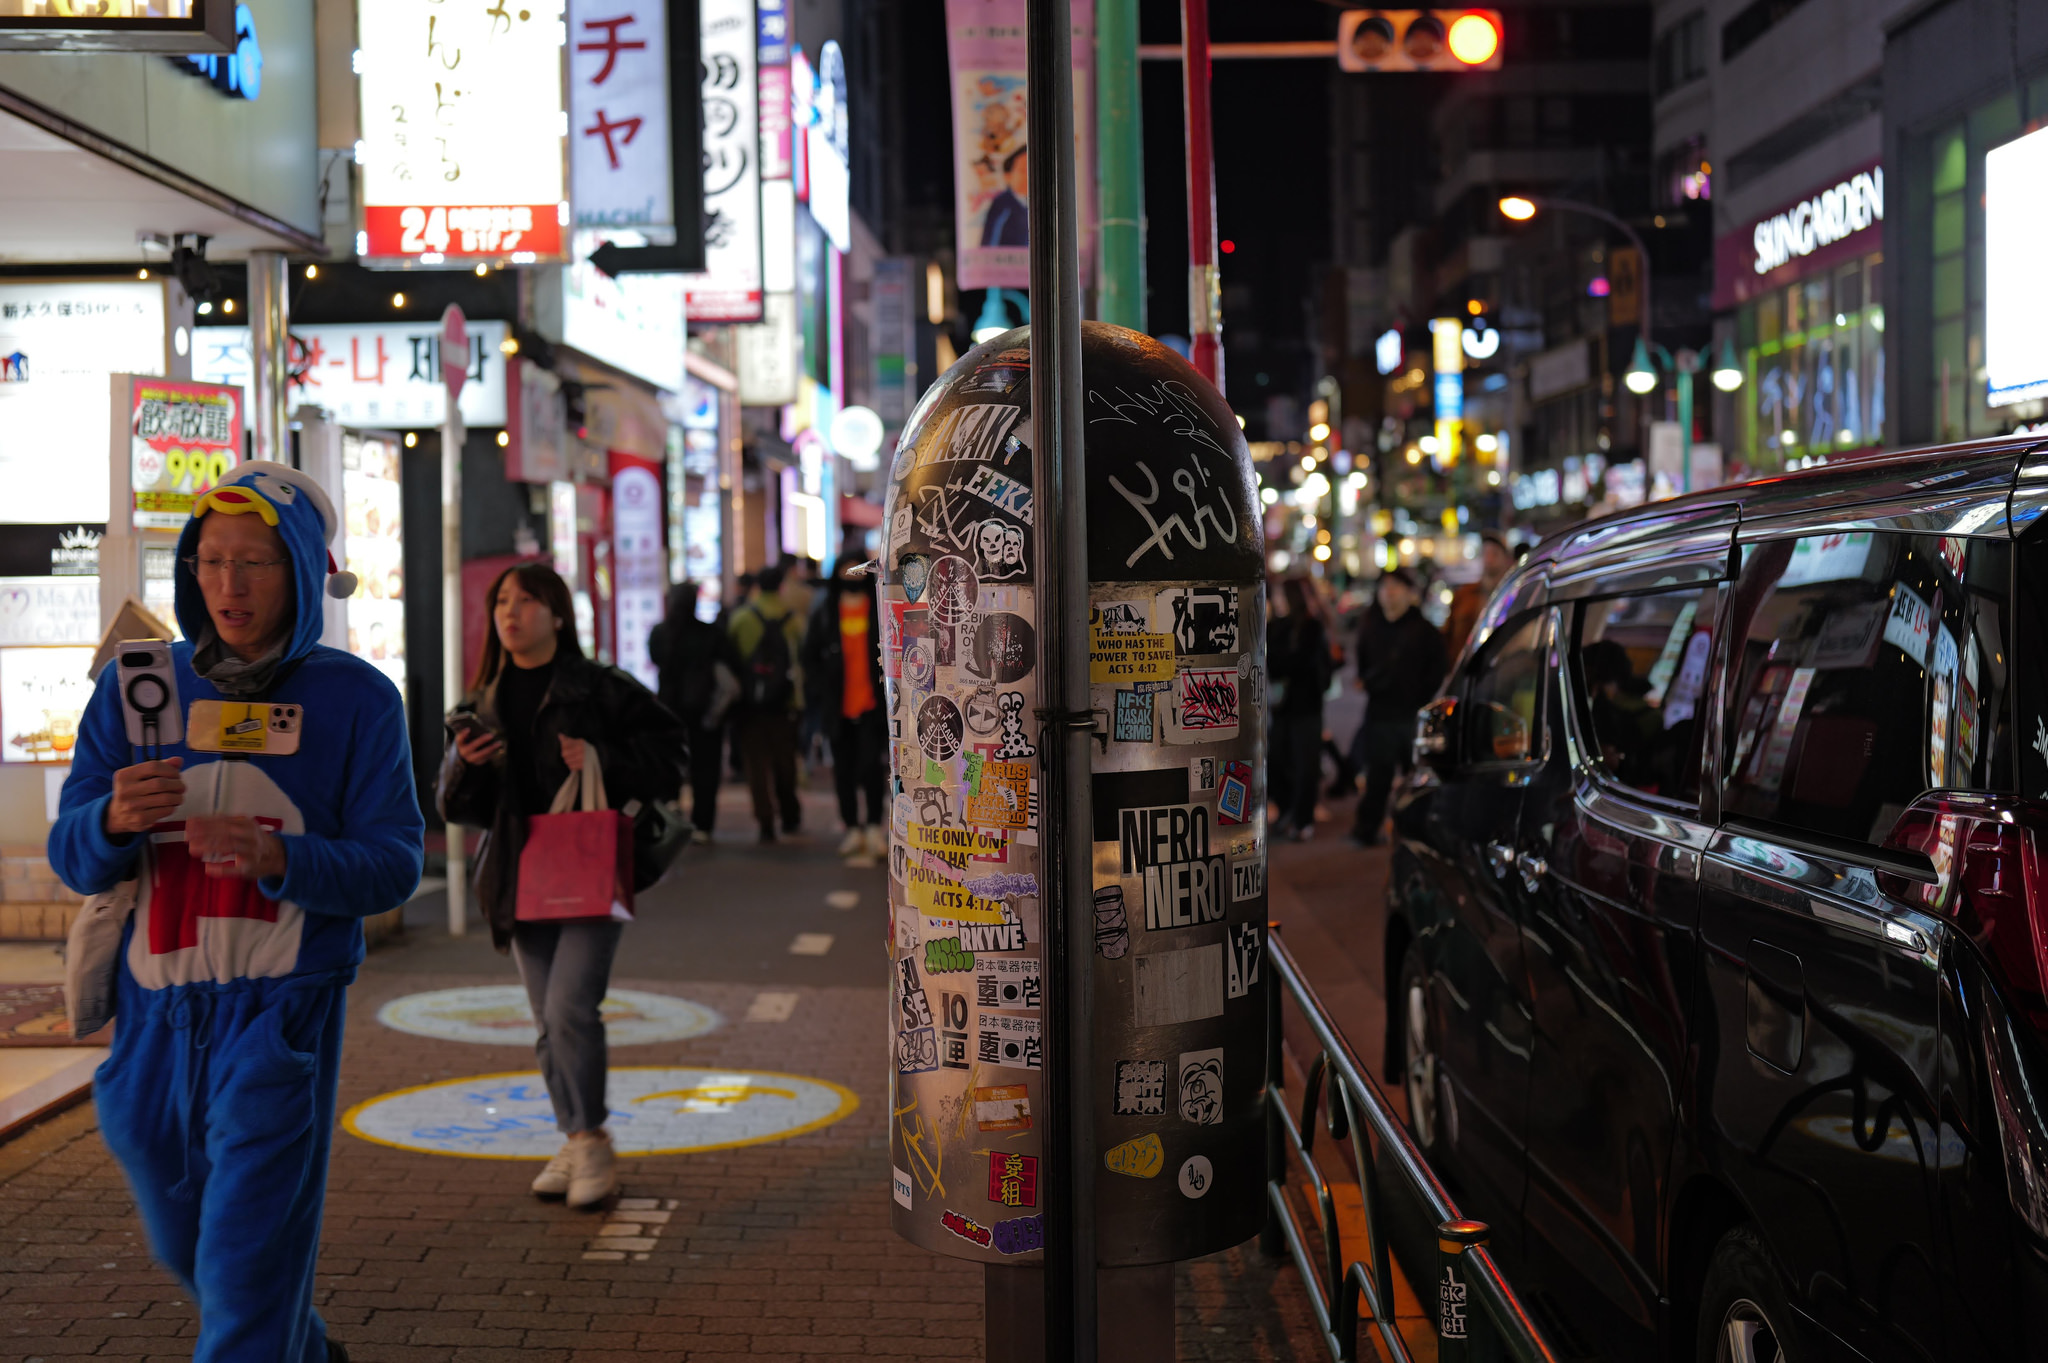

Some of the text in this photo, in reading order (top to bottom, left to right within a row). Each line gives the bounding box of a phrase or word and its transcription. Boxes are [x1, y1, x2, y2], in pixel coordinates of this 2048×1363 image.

[1090, 650, 1173, 662] POWER TO SAVE!
[1097, 638, 1165, 650] WHO HAS THE
[1108, 663, 1157, 675] ACTS 4:12
[1117, 707, 1153, 726] RASAK
[919, 721, 960, 750] SLIM RADIO
[917, 827, 939, 845] THE
[942, 829, 975, 848] ONLY
[1233, 863, 1262, 897] TAYE
[933, 890, 994, 912] ACTS 4:12
[1145, 857, 1226, 930] NERO
[958, 924, 1023, 951] RKYVE
[941, 992, 968, 1031] 10
[1000, 1153, 1025, 1207] 愛組
